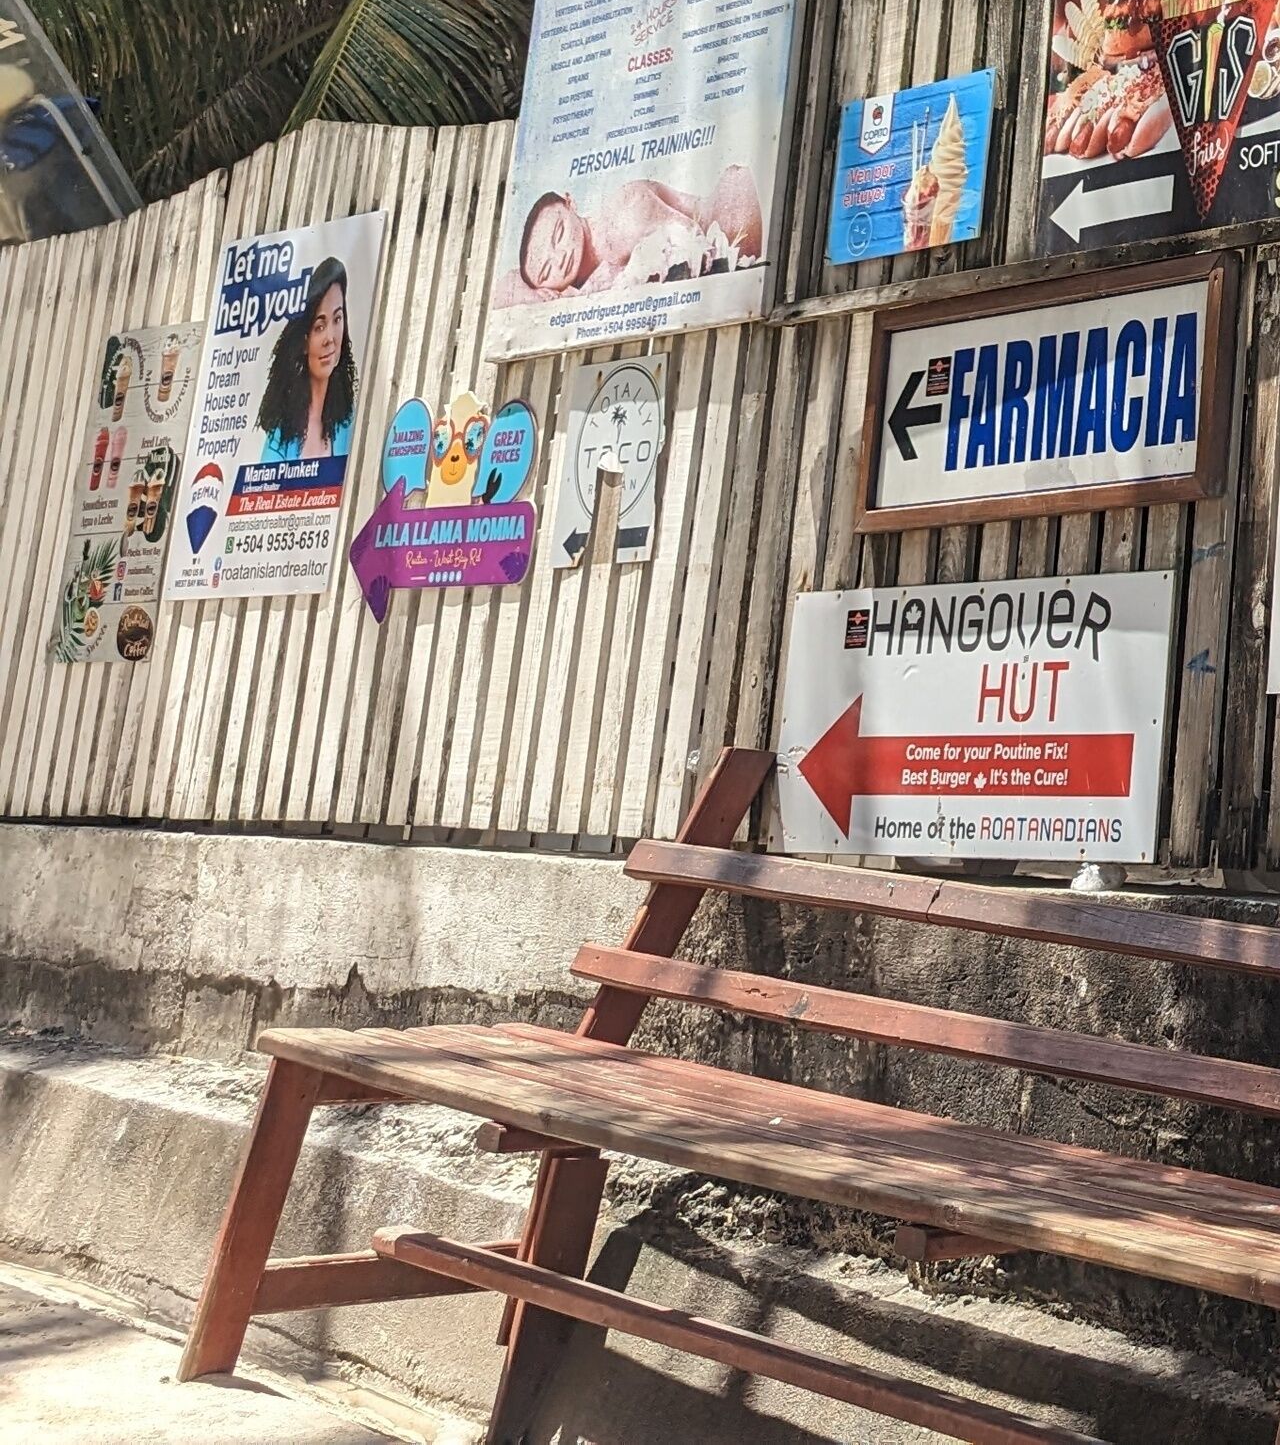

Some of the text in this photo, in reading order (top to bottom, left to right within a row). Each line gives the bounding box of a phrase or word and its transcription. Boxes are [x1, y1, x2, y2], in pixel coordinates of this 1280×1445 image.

[627, 48, 673, 72] CLASSES:
[569, 144, 635, 177] PERSONAL
[1239, 140, 1280, 171] SOFT
[223, 244, 293, 287] Let me
[217, 276, 310, 333] help you!
[603, 320, 624, 334] +504
[211, 346, 260, 370] Find your
[207, 371, 240, 390] Dream
[944, 311, 1198, 472] FARMACIA
[204, 391, 250, 412] House or
[201, 414, 248, 434] Businnes
[197, 436, 241, 460] Property
[494, 430, 525, 447] GREAT
[490, 448, 521, 465] PRICES
[244, 460, 319, 483] Marian Plunkett
[239, 491, 337, 513] The Real Estate Leaders
[235, 529, 330, 554] +504 9553-6518
[374, 514, 526, 548] LALA LLAMA MOMMA
[221, 561, 328, 581] roatanislandrealtor
[977, 660, 1070, 723] HUT
[905, 740, 1069, 763] Come for your Poutine Fix!
[901, 767, 1068, 790] Best Burger It's the Cure!
[874, 816, 1123, 843] Home of the ROATANADIANS
